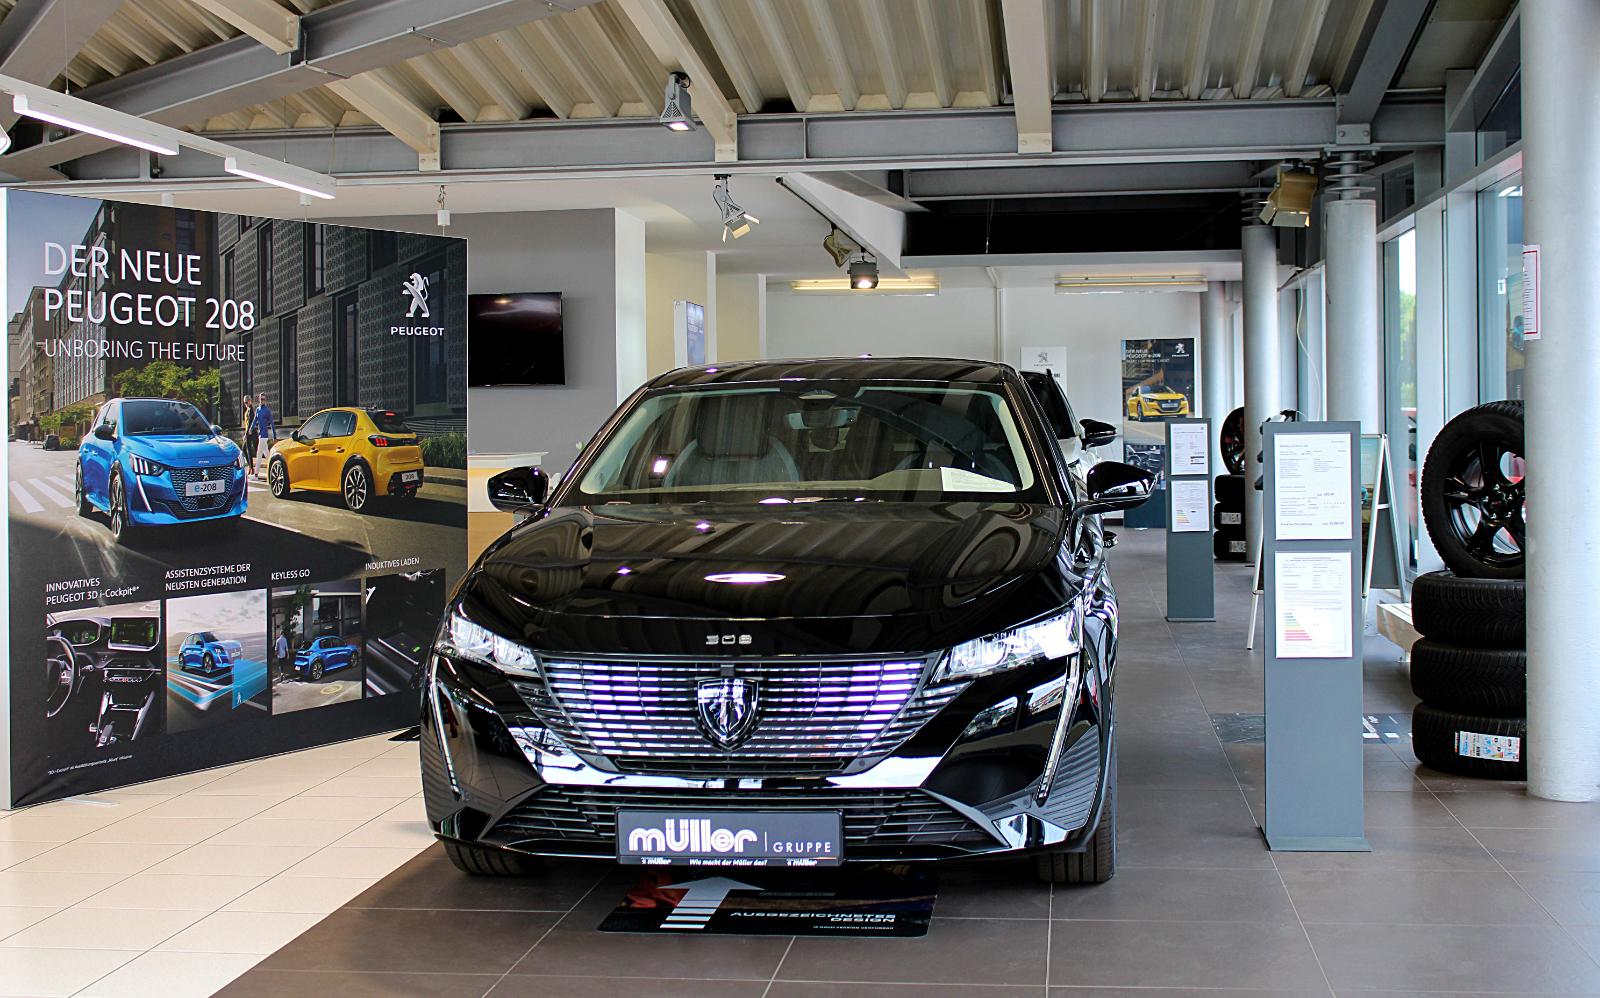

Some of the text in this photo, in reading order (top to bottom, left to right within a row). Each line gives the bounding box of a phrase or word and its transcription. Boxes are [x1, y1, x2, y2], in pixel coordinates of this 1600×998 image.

[44, 241, 203, 287] DER NEUE
[44, 288, 255, 331] PEUGEOT 208
[390, 326, 445, 336] PEUGEOT
[44, 338, 246, 362] UNBORING THE FUTURE
[194, 483, 217, 492] e-208
[165, 563, 251, 579] ASSISTENZSYSTEME DER
[365, 557, 420, 571] INDUKTIVES LADEN
[271, 568, 311, 581] KEYLESS GO
[46, 577, 101, 593] INNOVATIVES
[165, 576, 247, 592] NEUSTEN GENERATION
[46, 591, 86, 606] PEUGEOT
[86, 591, 99, 600] 3D
[705, 634, 753, 645] 308
[628, 818, 758, 853] müller
[772, 841, 832, 853] GRUPPE
